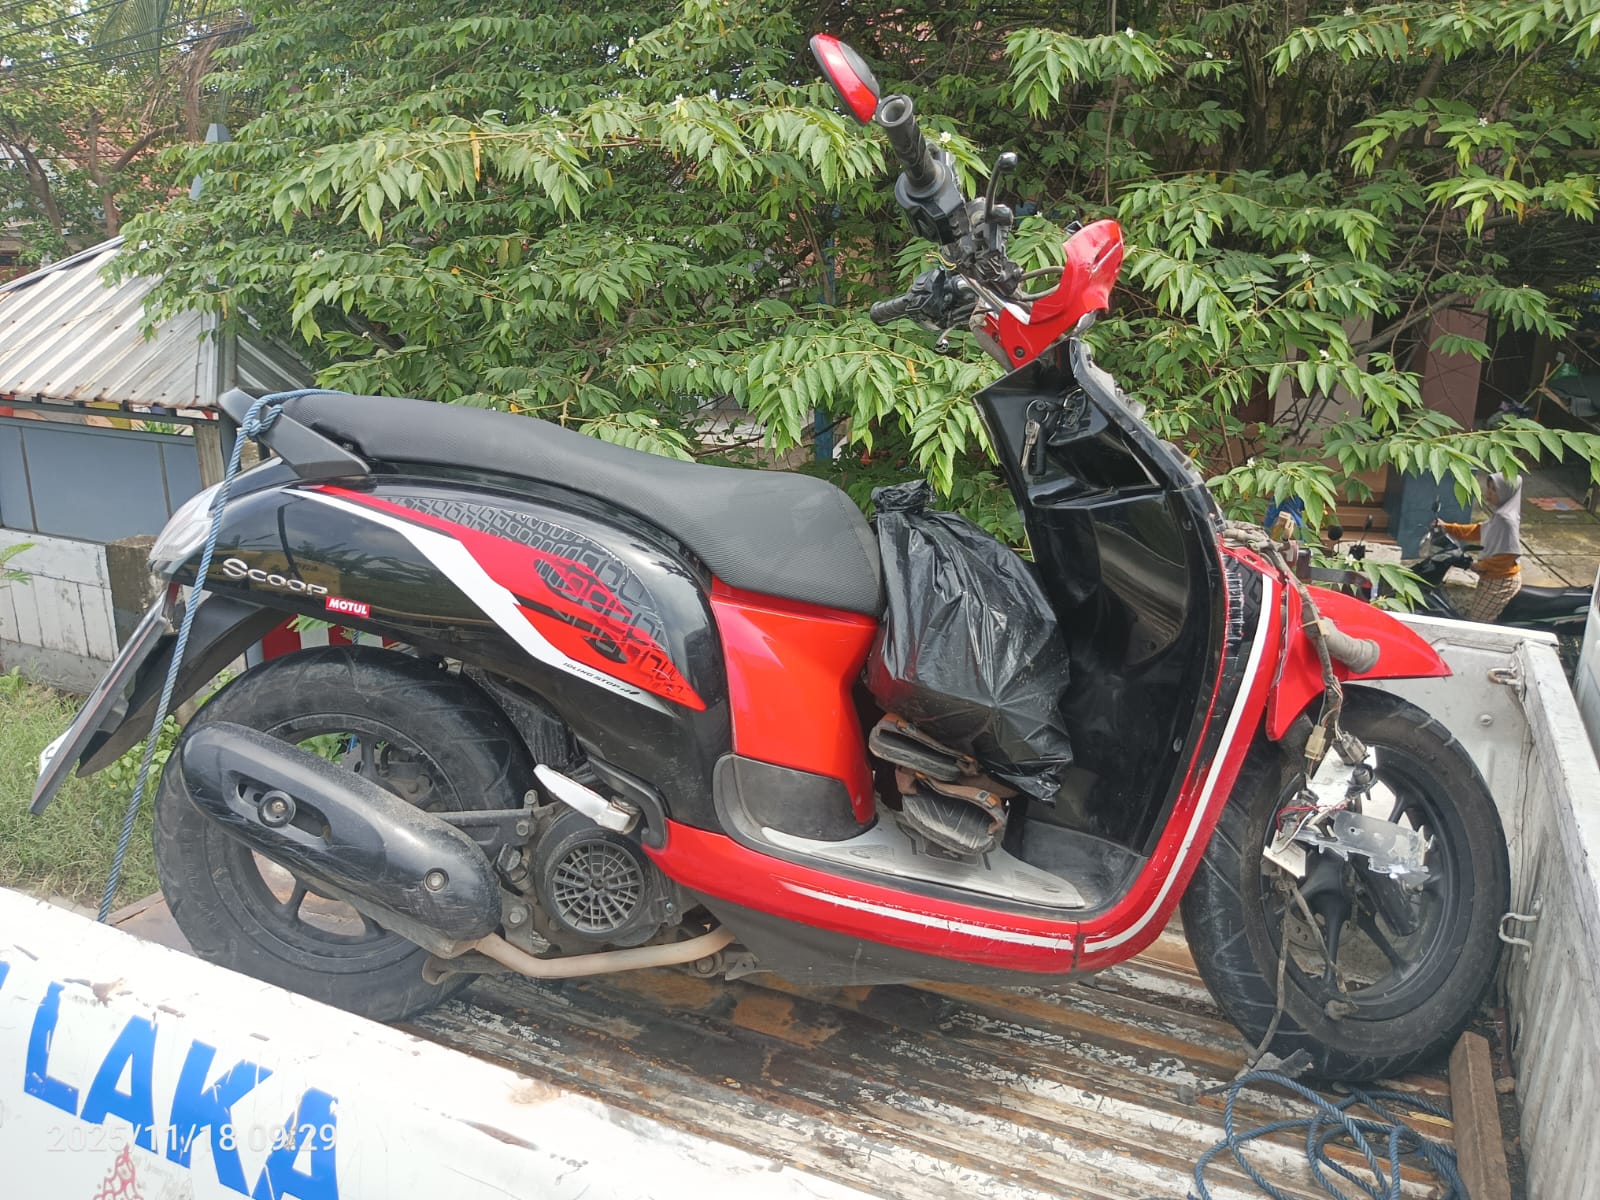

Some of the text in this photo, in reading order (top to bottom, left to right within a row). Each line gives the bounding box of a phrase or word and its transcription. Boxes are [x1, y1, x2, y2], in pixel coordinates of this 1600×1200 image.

[328, 598, 368, 615] MOTUL
[563, 662, 621, 688] IDLING STOP
[24, 981, 342, 1200] LAKA
